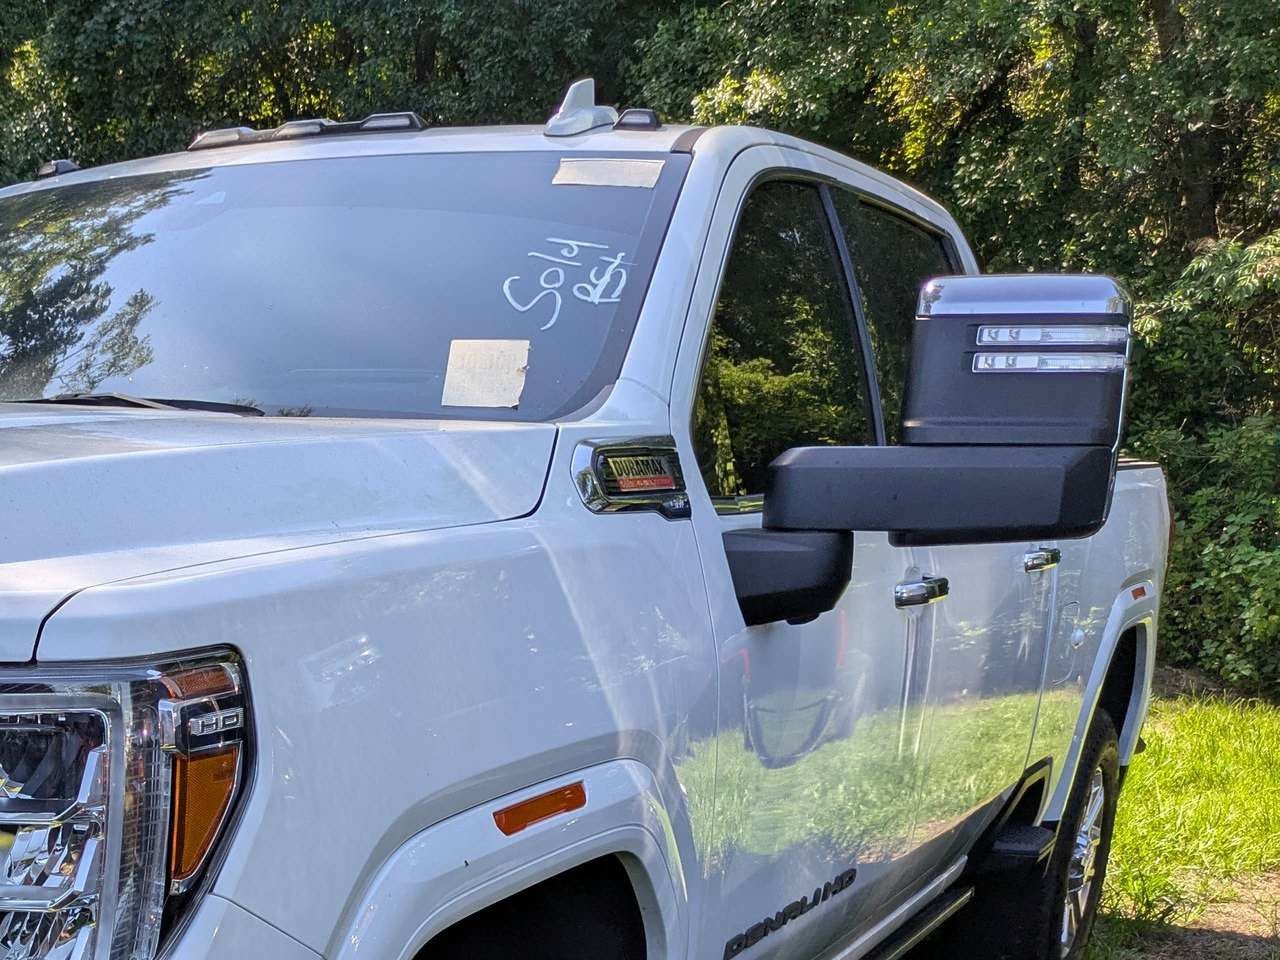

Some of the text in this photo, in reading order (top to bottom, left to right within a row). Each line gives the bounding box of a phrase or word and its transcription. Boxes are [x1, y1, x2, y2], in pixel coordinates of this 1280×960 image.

[610, 456, 667, 477] DURAMAX
[195, 709, 243, 736] HD
[821, 867, 857, 902] HD
